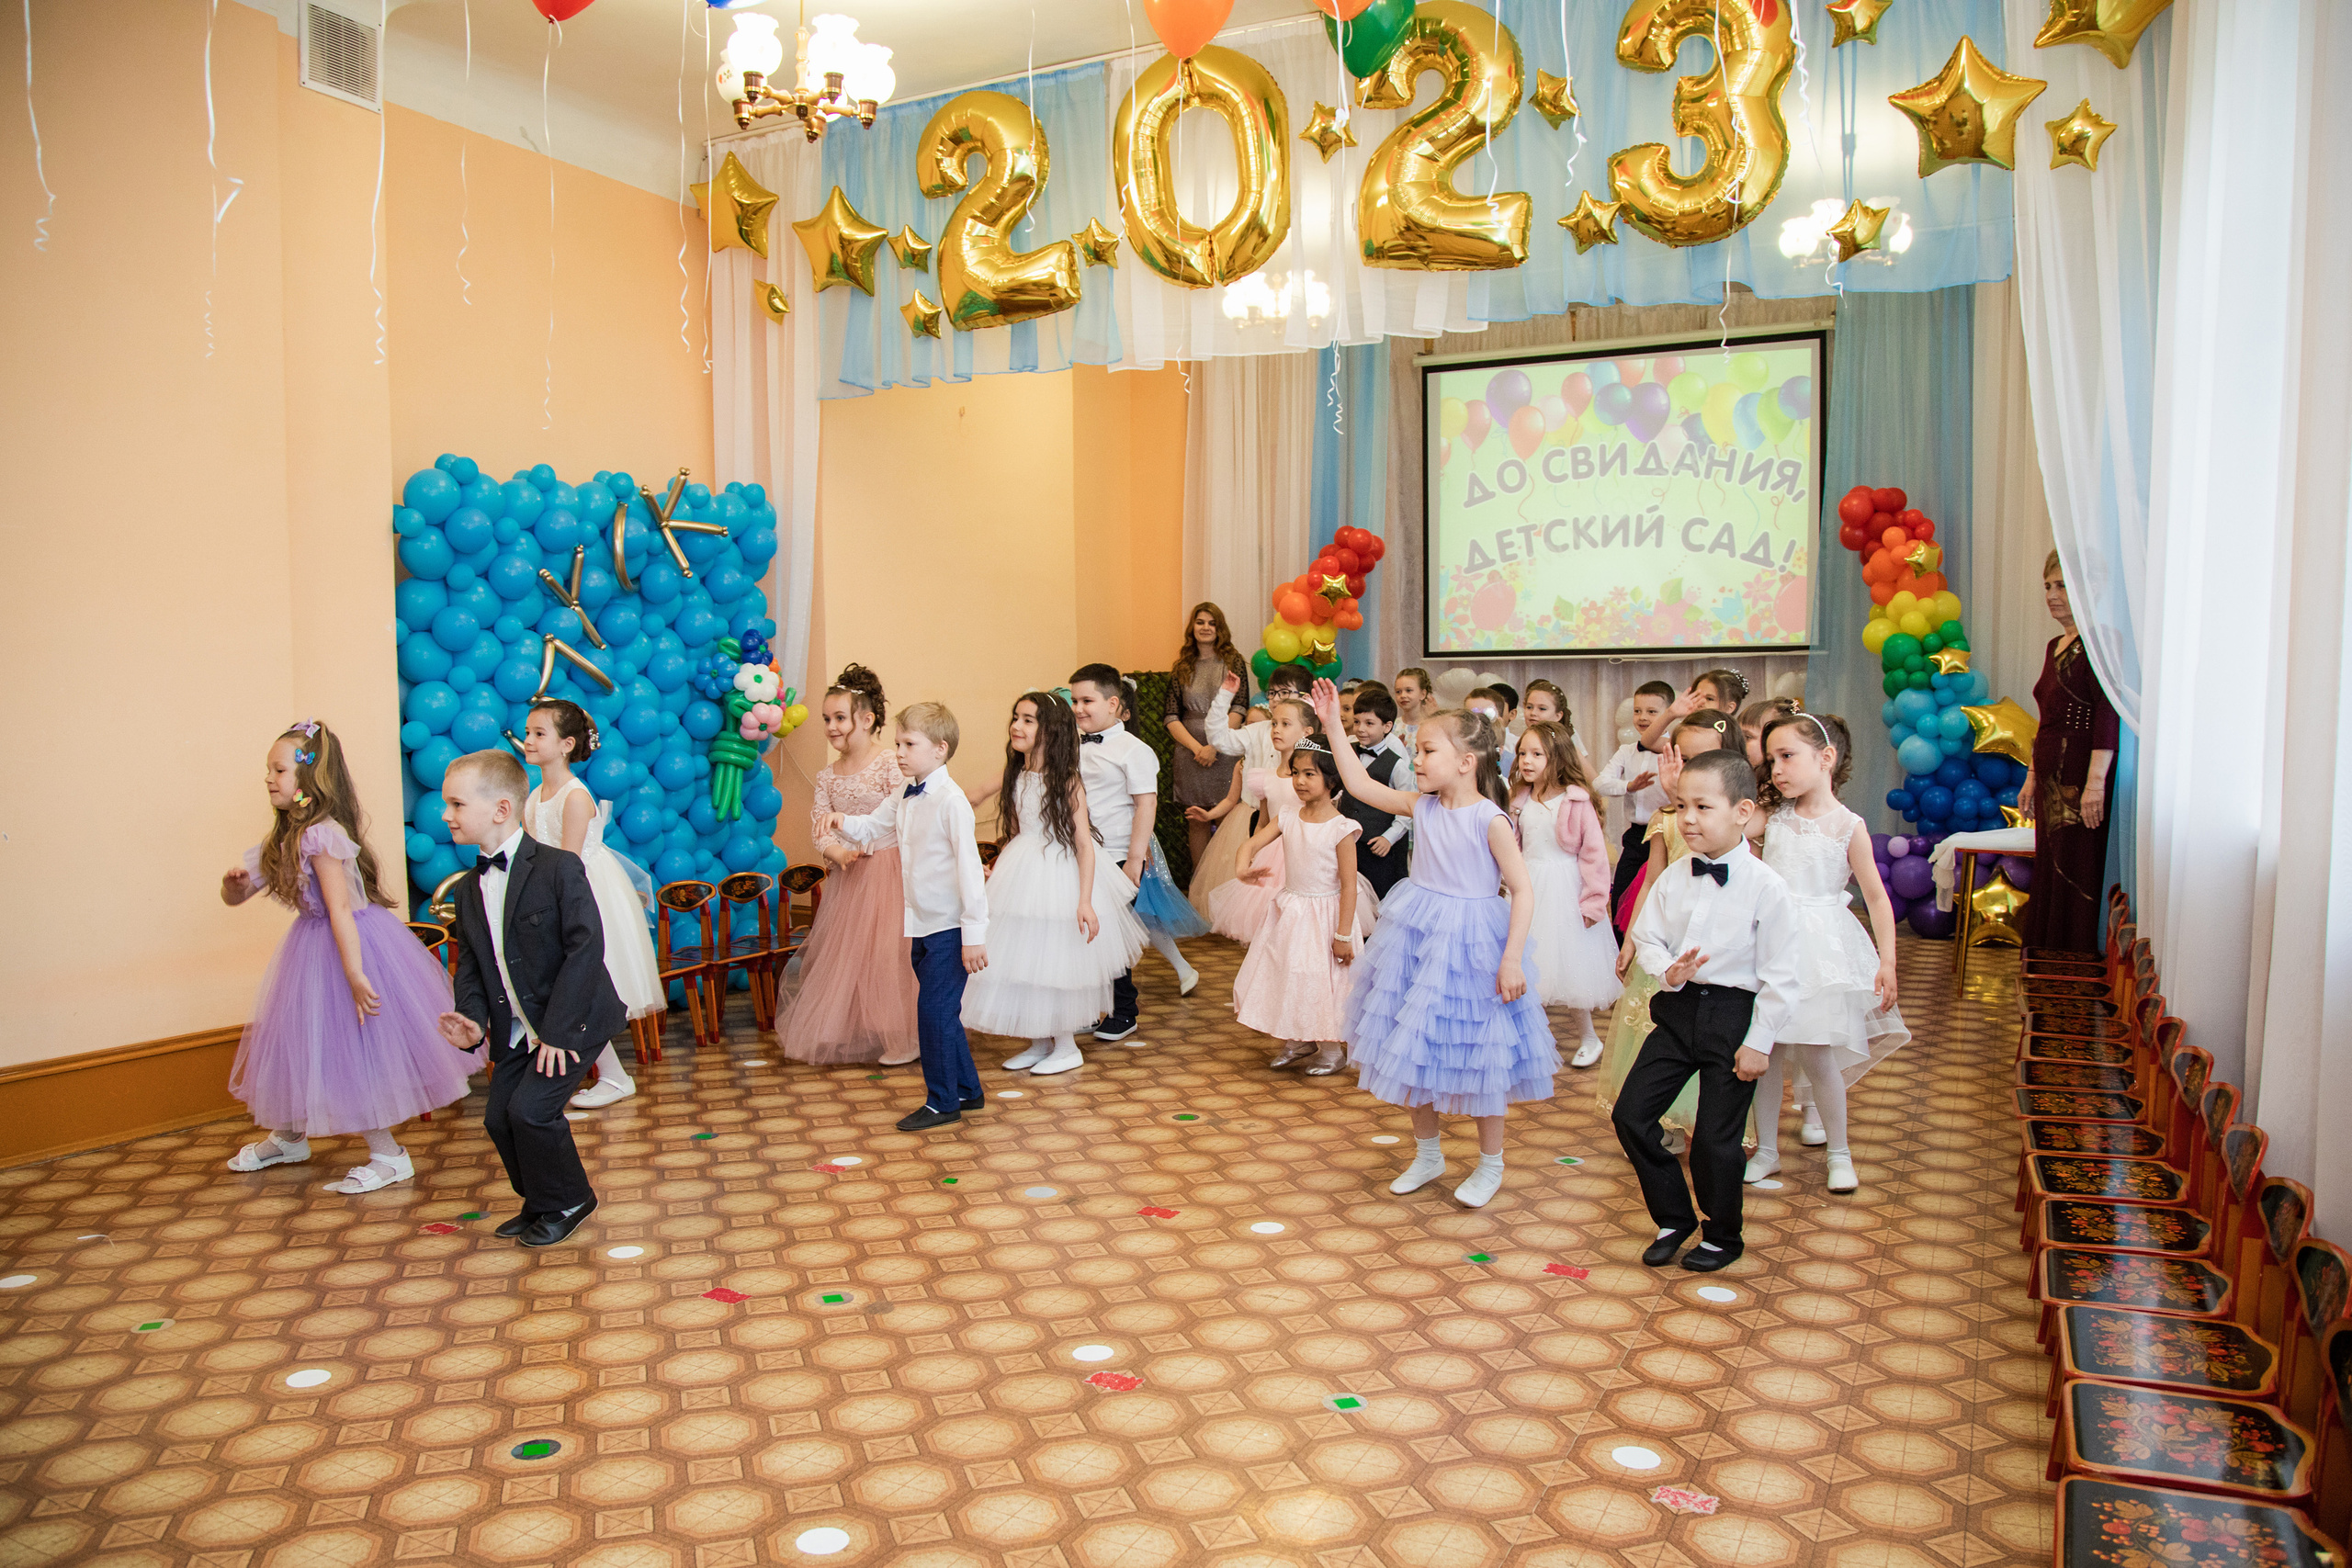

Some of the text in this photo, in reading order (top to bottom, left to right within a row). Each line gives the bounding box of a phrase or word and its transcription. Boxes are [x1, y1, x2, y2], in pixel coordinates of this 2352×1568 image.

[1464, 441, 1806, 509] ДО СВИДАНИЯ,
[1463, 504, 1798, 575] ДЕТСКИЙ САД!
